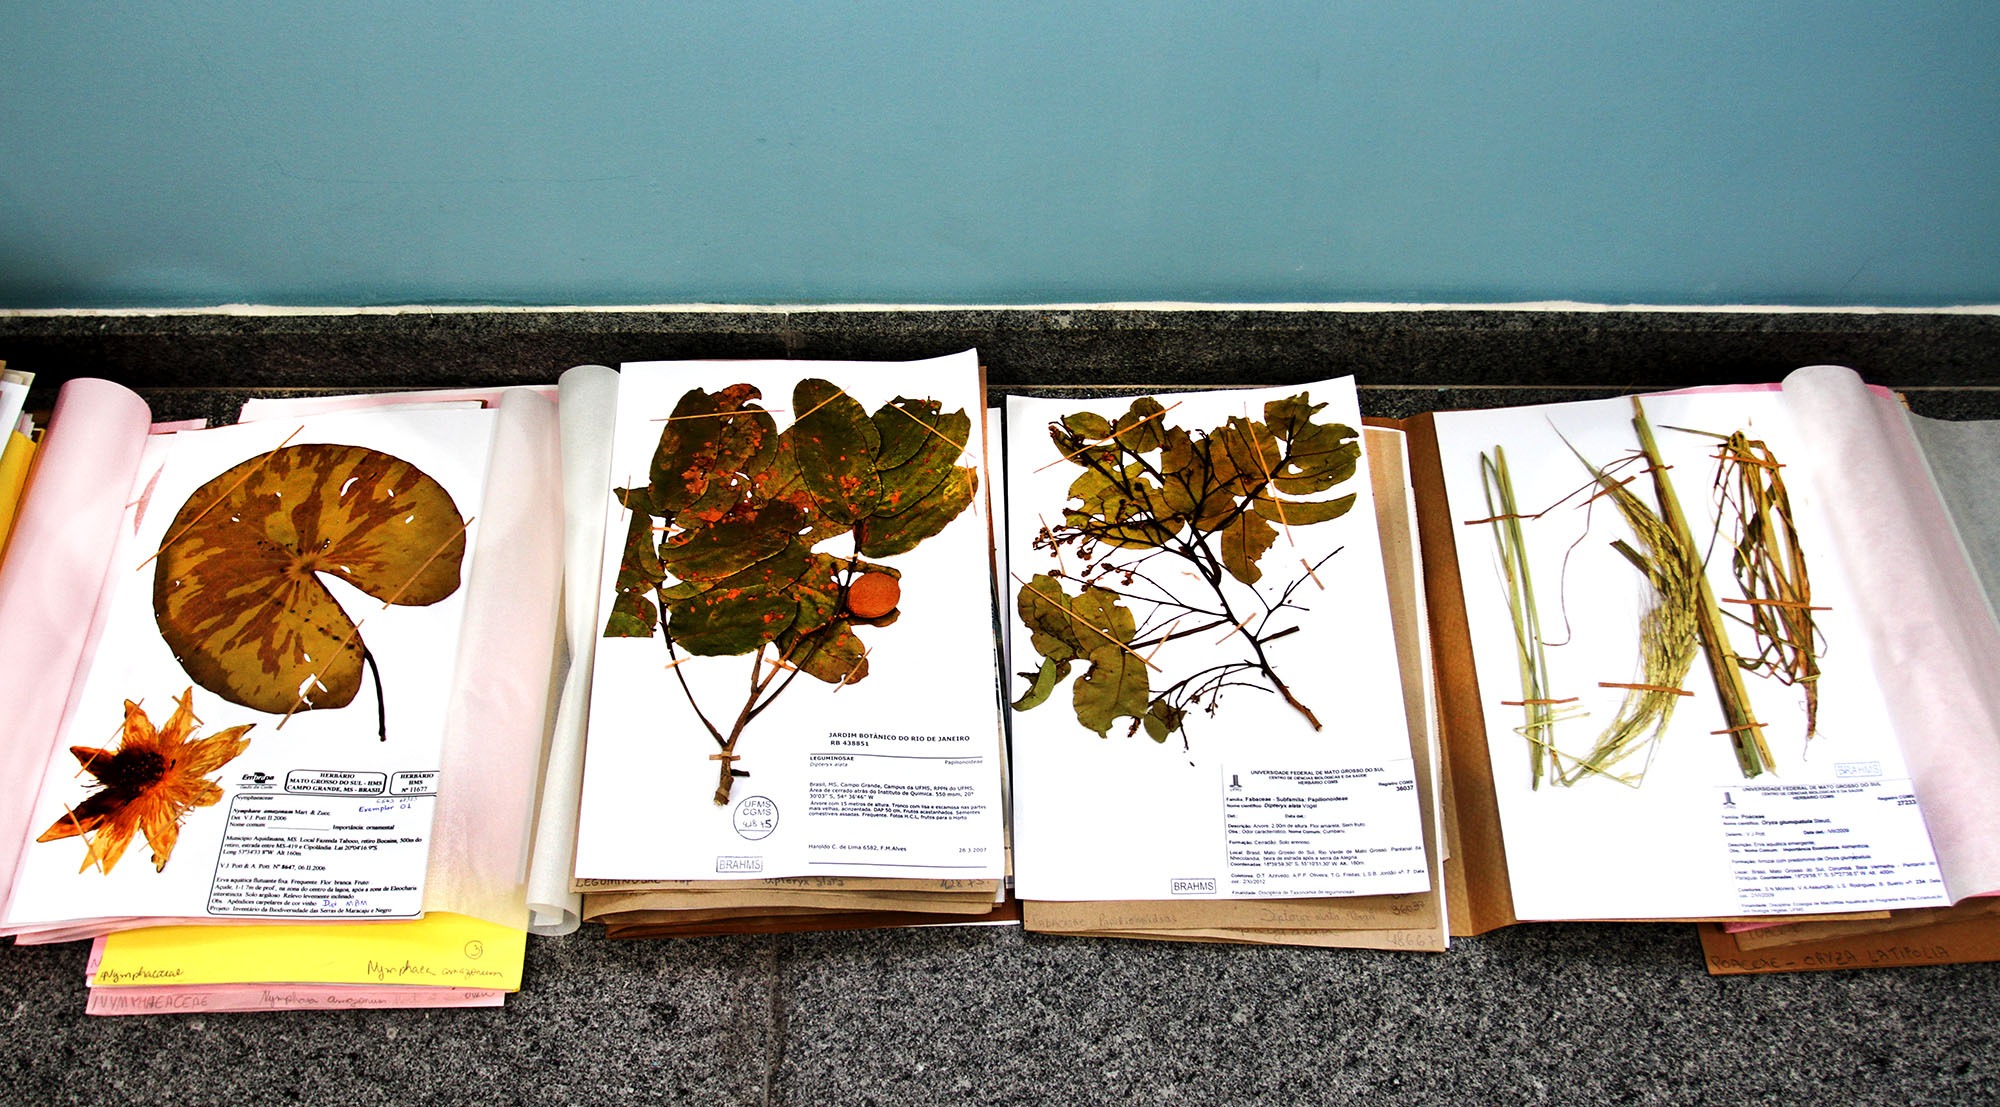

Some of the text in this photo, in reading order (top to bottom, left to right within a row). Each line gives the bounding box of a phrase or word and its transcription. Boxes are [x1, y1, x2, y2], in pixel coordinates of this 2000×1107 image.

[242, 772, 274, 783] Embrapa
[720, 860, 760, 869] BRAHMS
[1174, 882, 1213, 891] BRAHMS
